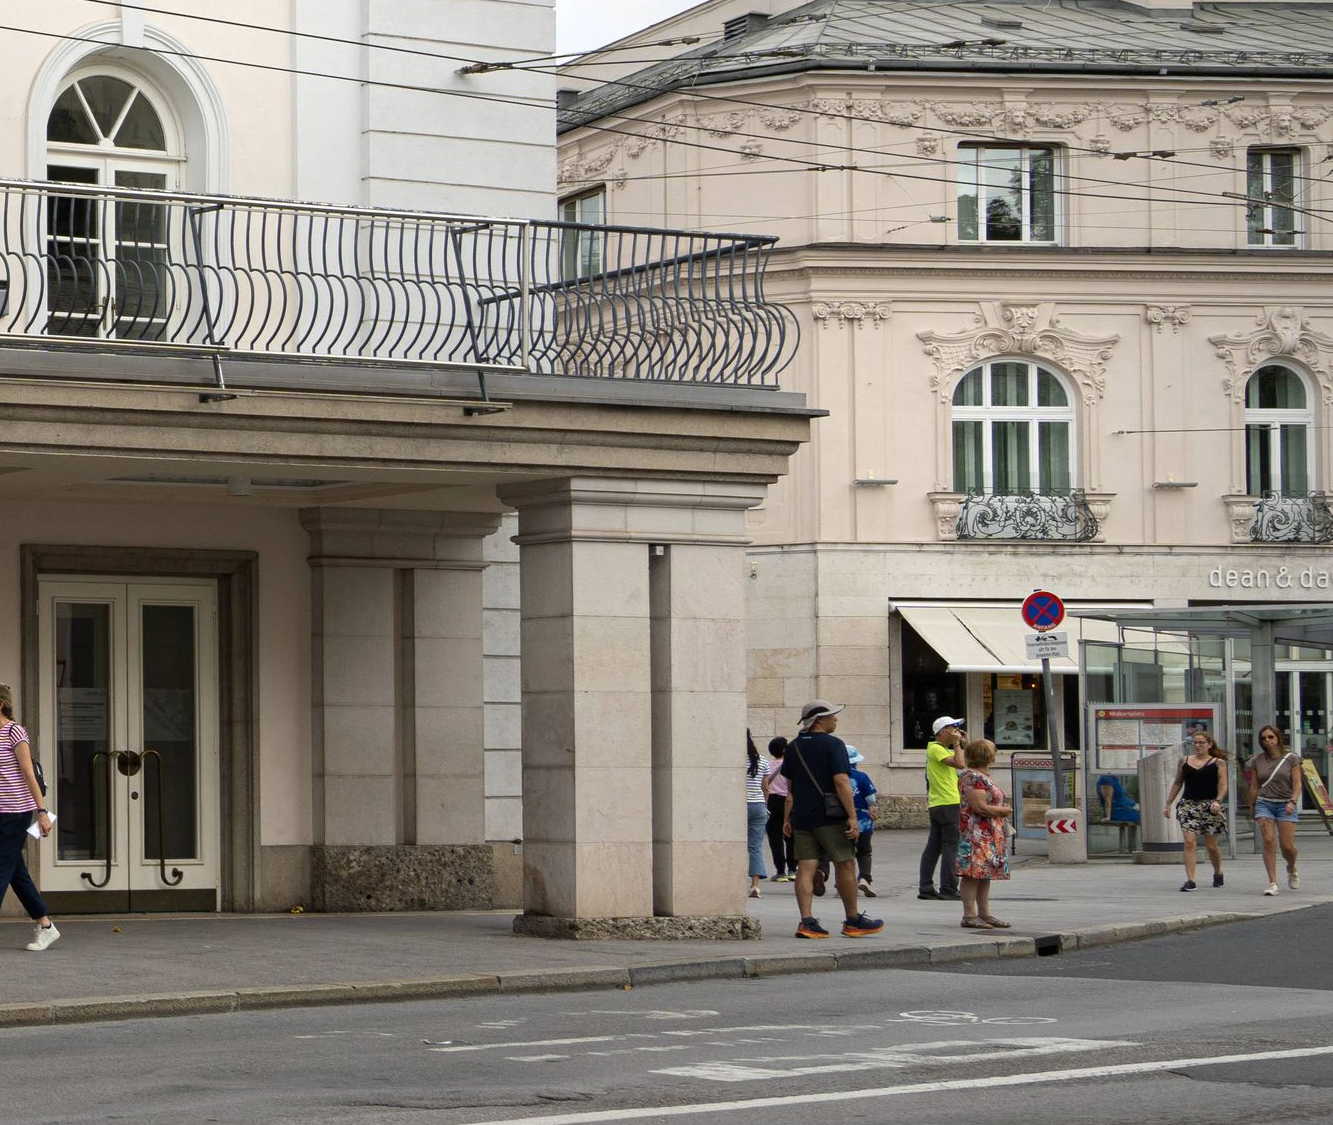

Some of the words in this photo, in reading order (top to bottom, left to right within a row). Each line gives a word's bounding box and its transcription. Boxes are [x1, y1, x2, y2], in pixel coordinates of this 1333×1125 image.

[1209, 564, 1270, 588] dean
[1275, 566, 1294, 588] &
[1300, 565, 1333, 588] da
